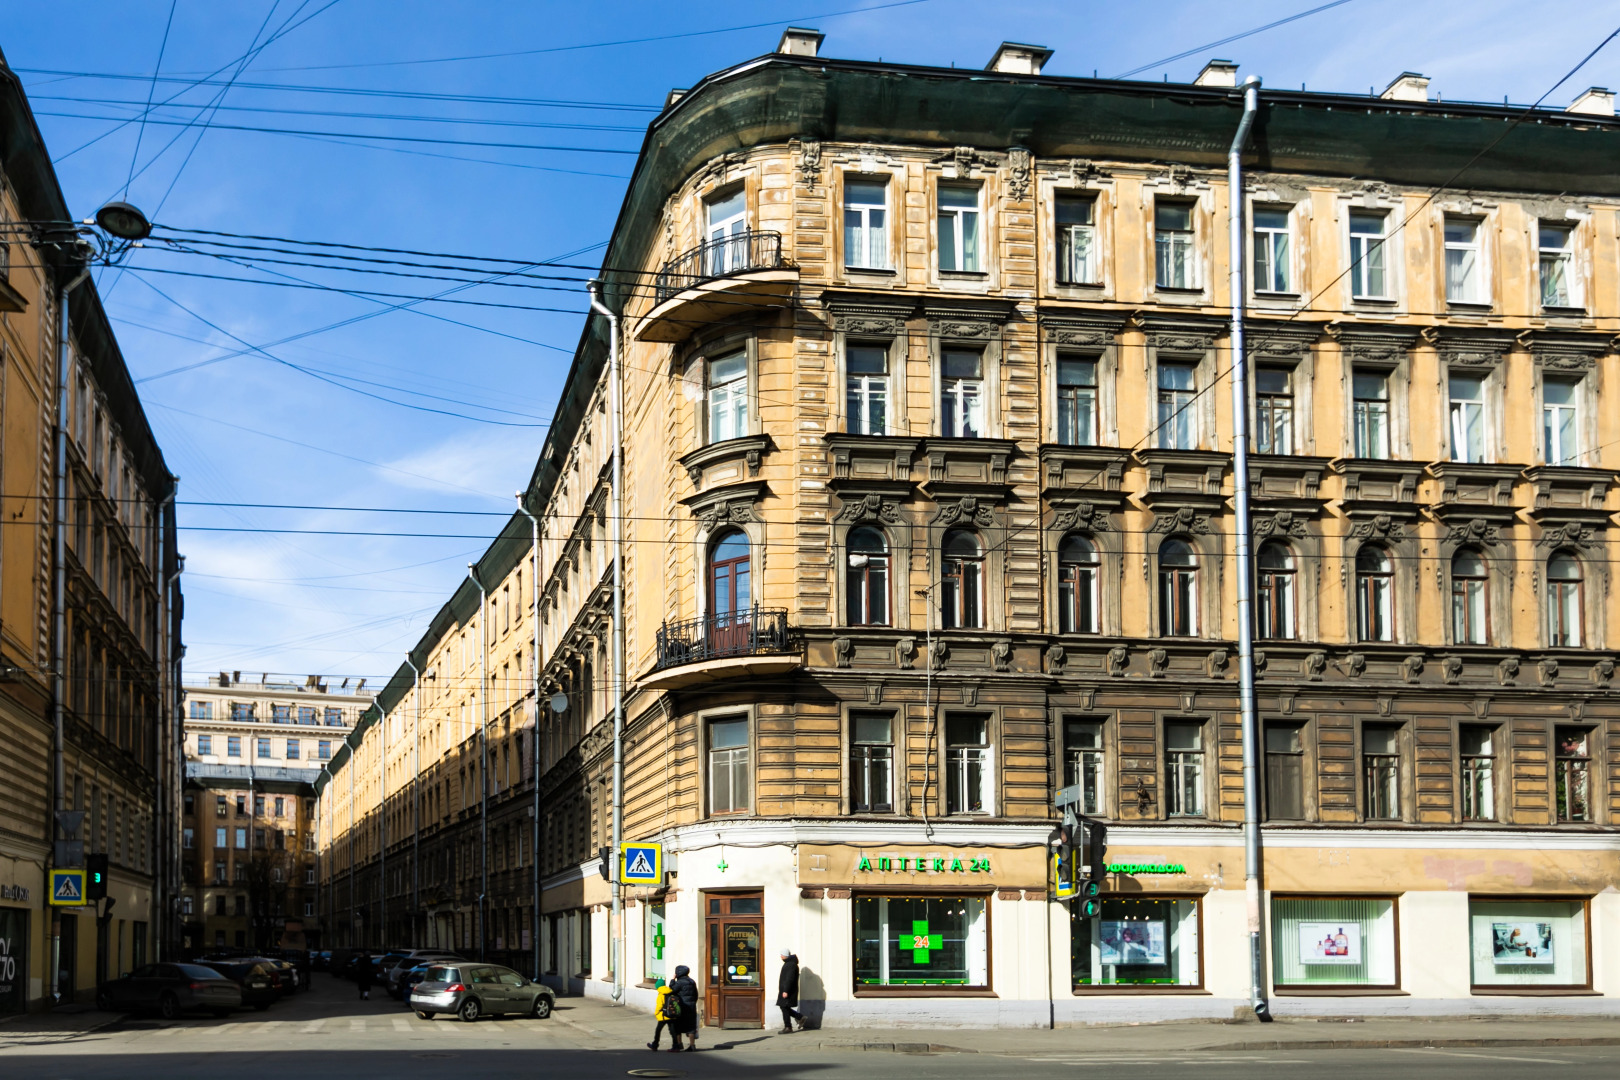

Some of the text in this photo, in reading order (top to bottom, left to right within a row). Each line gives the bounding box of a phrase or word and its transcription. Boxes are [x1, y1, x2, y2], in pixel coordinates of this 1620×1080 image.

[858, 857, 990, 871] АПТЕКА 24
[1103, 862, 1186, 875] фармадом
[95, 872, 101, 883] 3
[1090, 883, 1096, 895] 3
[914, 935, 930, 948] 24
